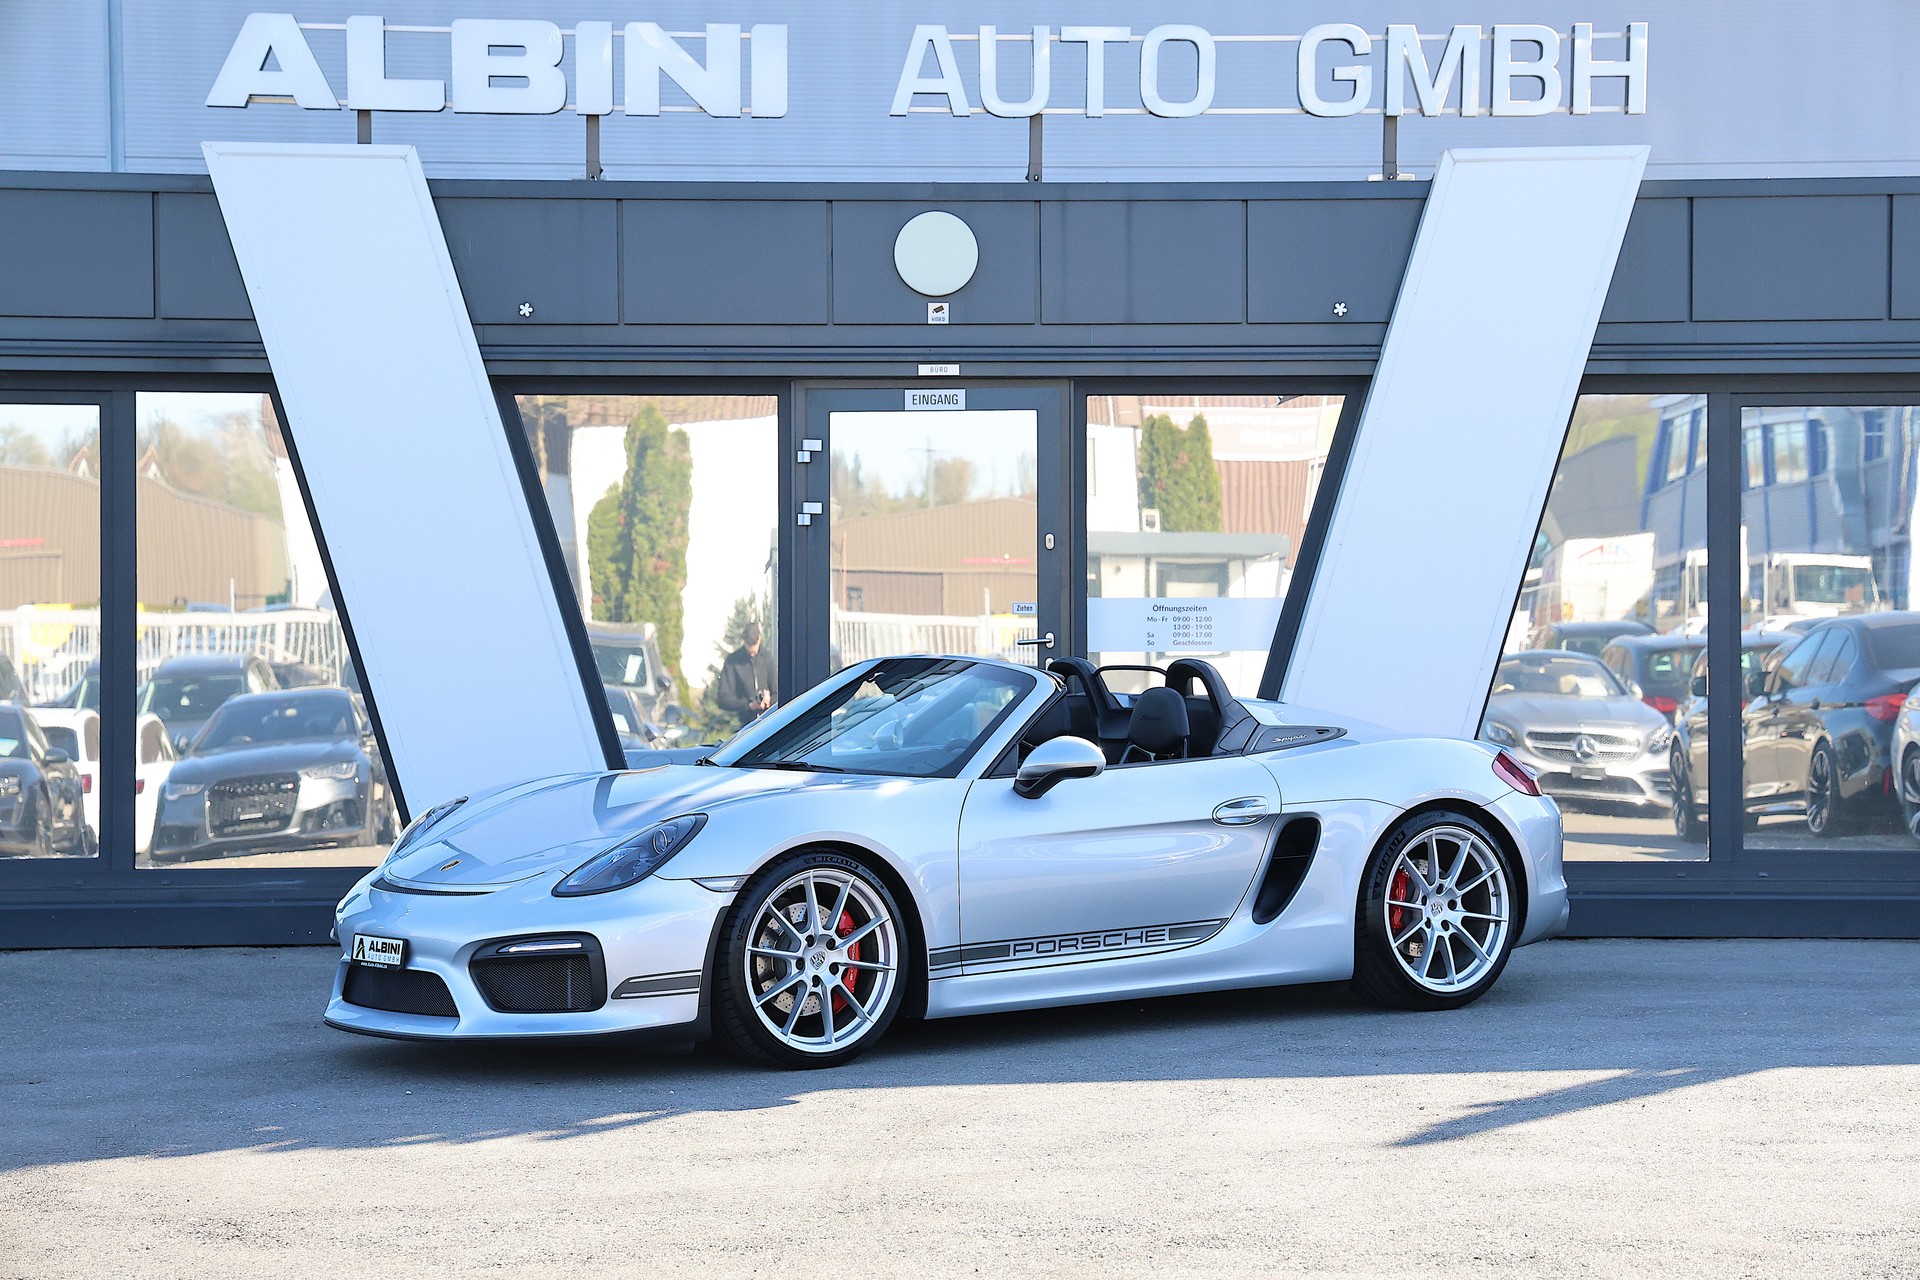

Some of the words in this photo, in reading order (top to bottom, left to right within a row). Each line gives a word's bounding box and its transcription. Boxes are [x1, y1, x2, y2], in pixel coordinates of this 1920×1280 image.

[205, 12, 788, 119] ALBINI
[889, 23, 1216, 119] AUTO
[1296, 21, 1649, 119] GMBH
[912, 393, 959, 405] EINGANG
[1152, 604, 1208, 613] Öffnungszeiten
[815, 856, 857, 869] MICHELIN
[368, 940, 401, 955] ALBINI
[1013, 929, 1166, 957] PORSCHE
[383, 954, 400, 963] GMBH
